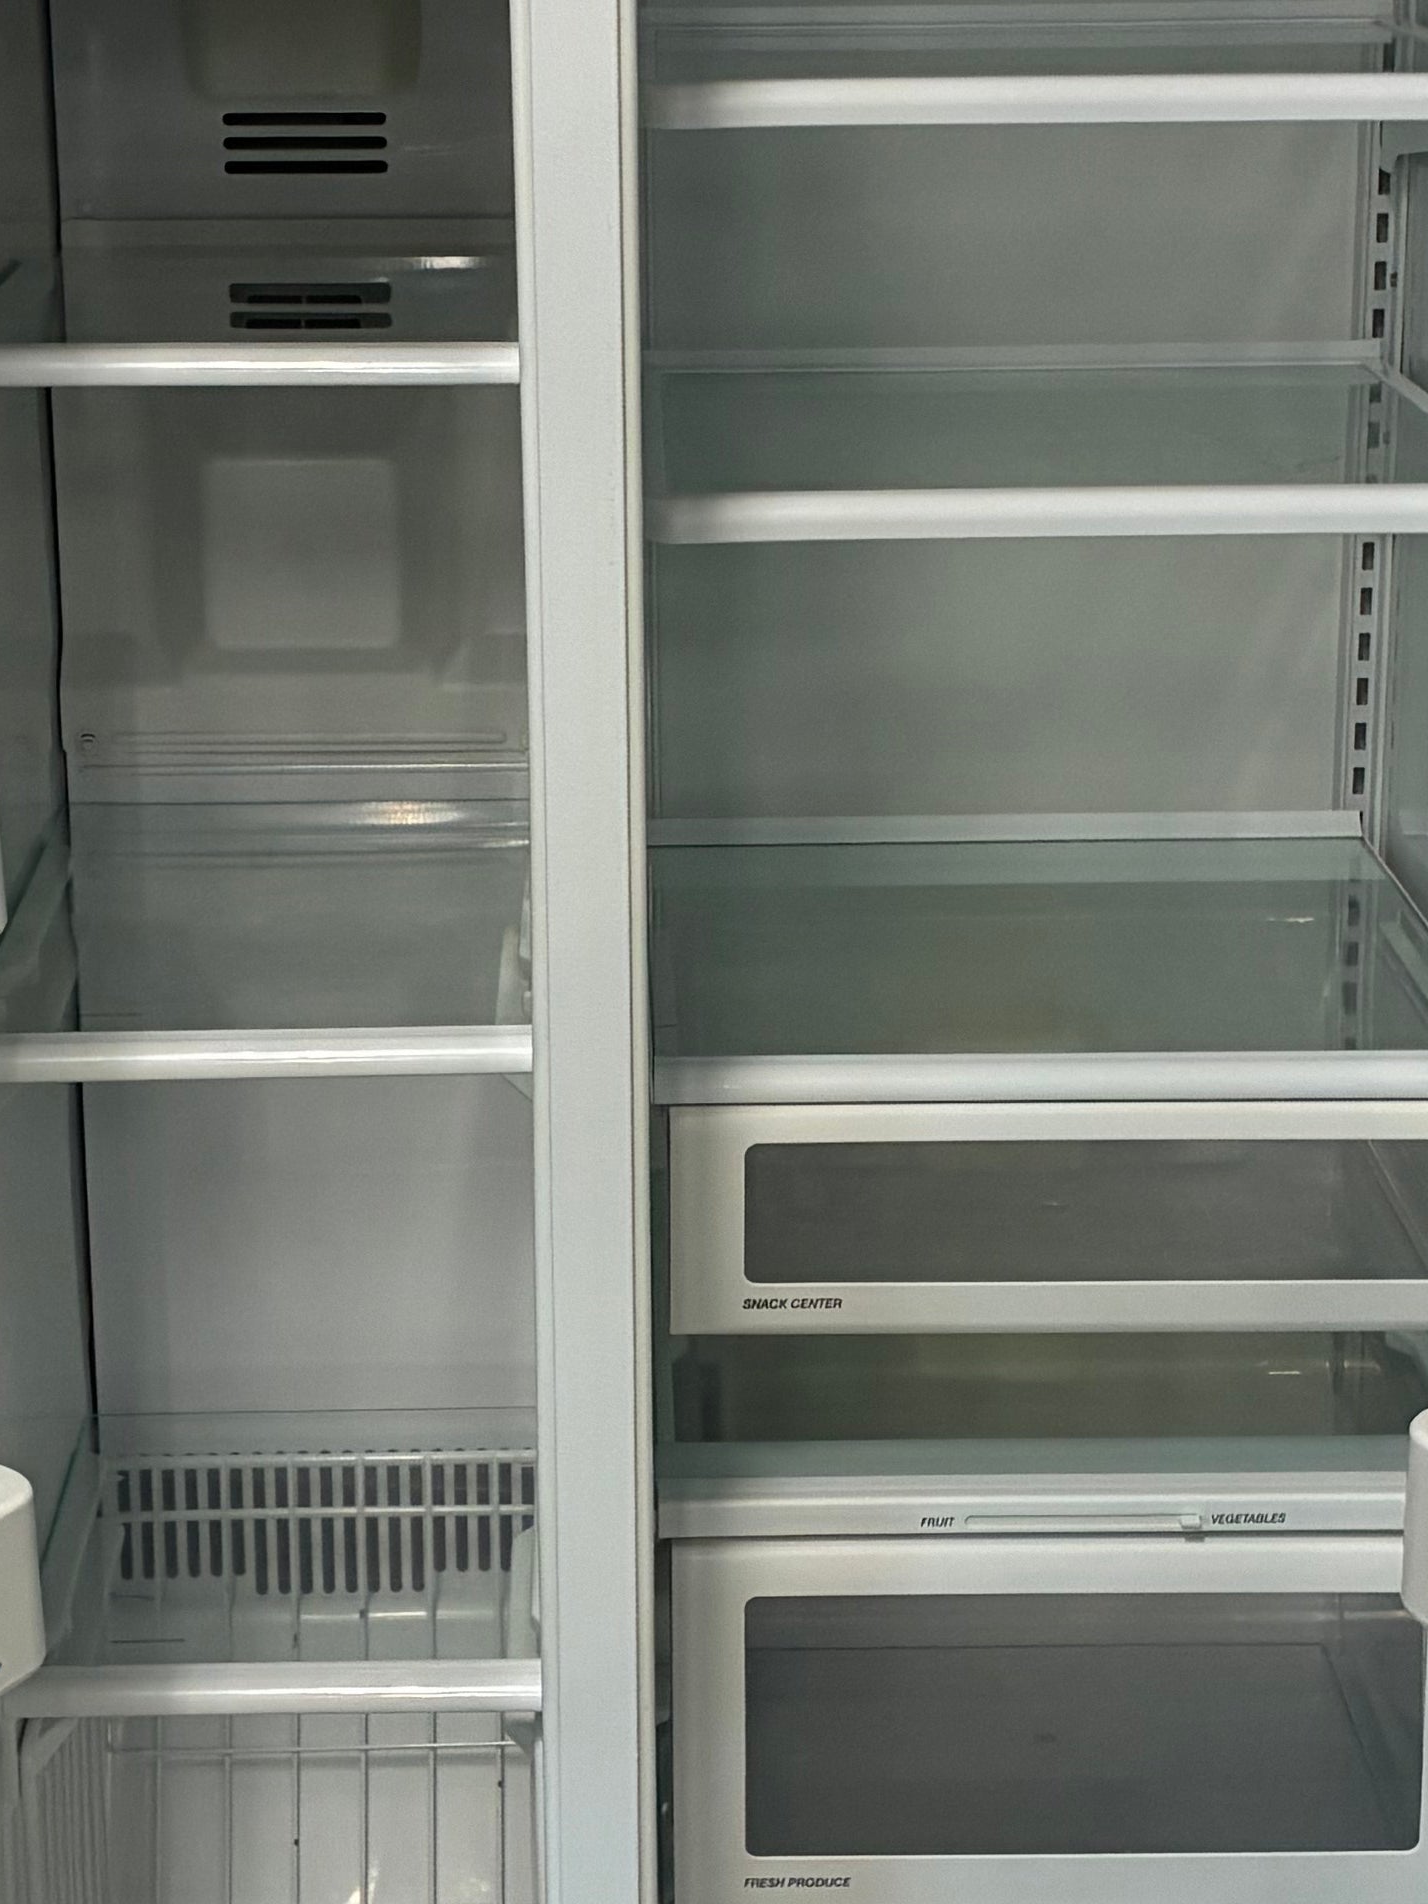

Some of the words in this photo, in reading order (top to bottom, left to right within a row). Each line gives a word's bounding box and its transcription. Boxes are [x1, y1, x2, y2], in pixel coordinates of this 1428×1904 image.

[742, 1298, 789, 1310] SNACK
[790, 1297, 843, 1309] CENTER
[920, 1516, 955, 1528] FRUIT
[1211, 1512, 1287, 1525] VEGETABLES
[743, 1877, 786, 1888] FRESH
[787, 1877, 852, 1888] PRODUCE
